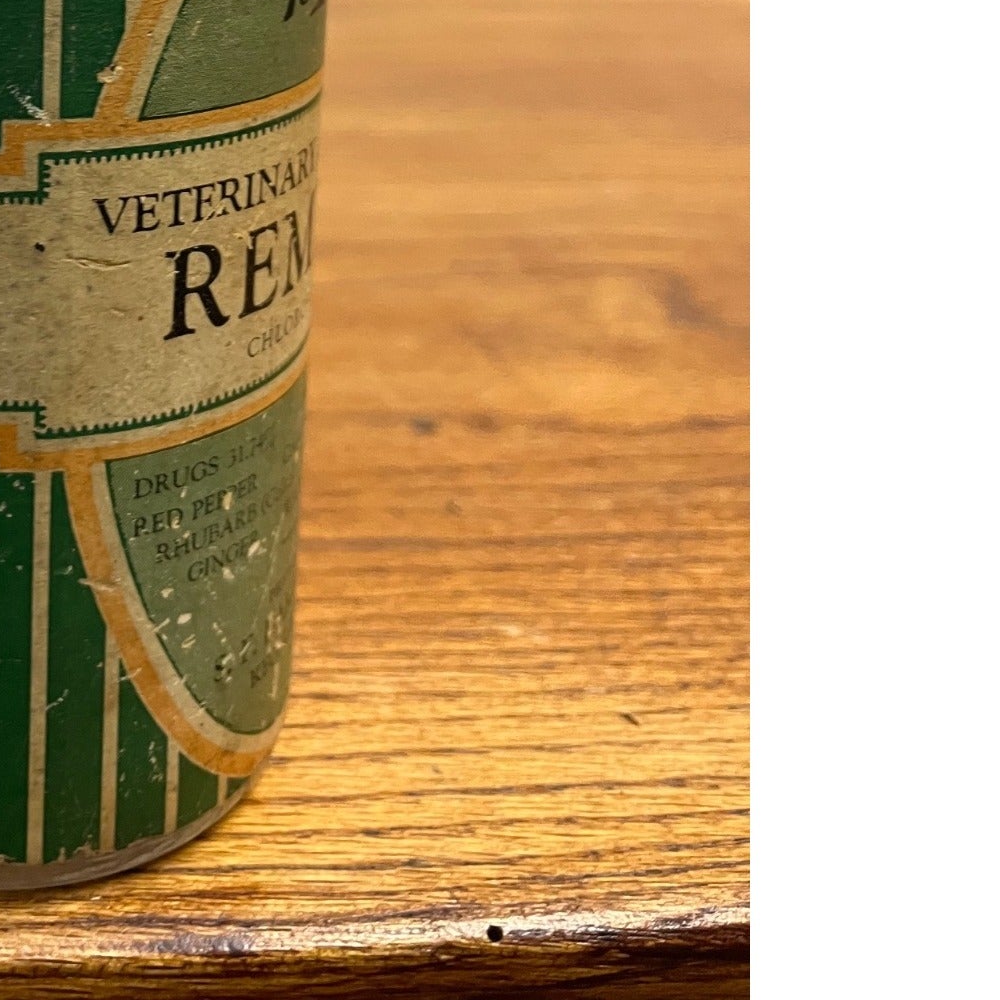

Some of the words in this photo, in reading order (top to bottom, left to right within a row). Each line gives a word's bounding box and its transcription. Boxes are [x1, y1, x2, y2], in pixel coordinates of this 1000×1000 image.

[133, 455, 219, 499] DRUGS
[133, 508, 183, 538] RED
[192, 473, 258, 520] PEPPER
